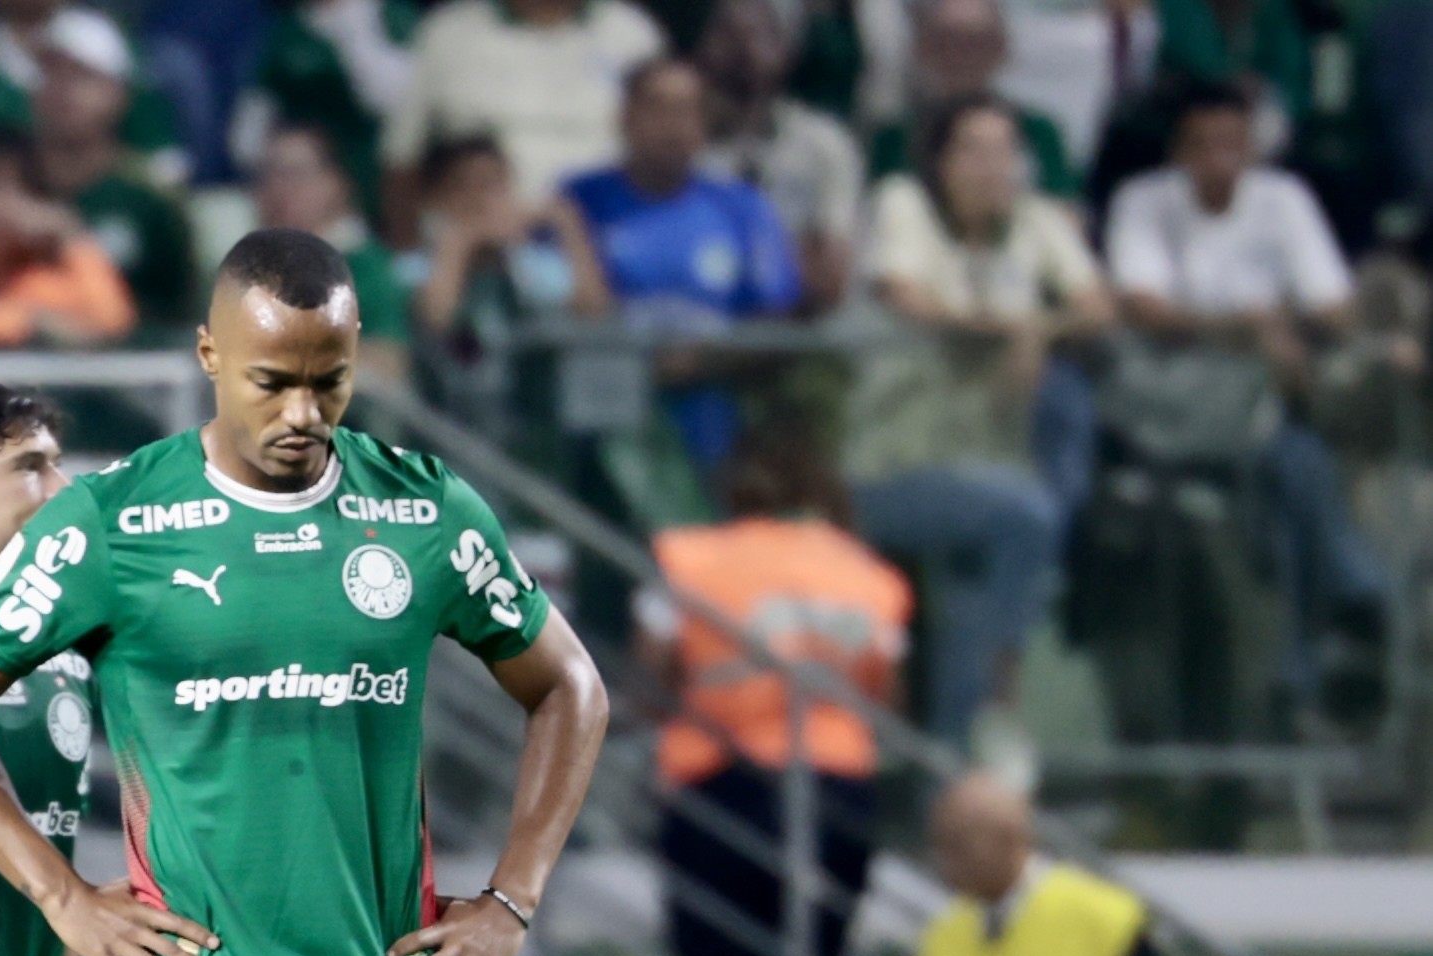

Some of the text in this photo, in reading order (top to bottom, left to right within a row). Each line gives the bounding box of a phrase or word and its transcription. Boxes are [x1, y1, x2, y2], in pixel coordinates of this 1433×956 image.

[118, 498, 230, 534] CIMED
[337, 494, 439, 524] CIMED
[255, 540, 323, 553] Embracon
[174, 663, 409, 711] sportingbet
